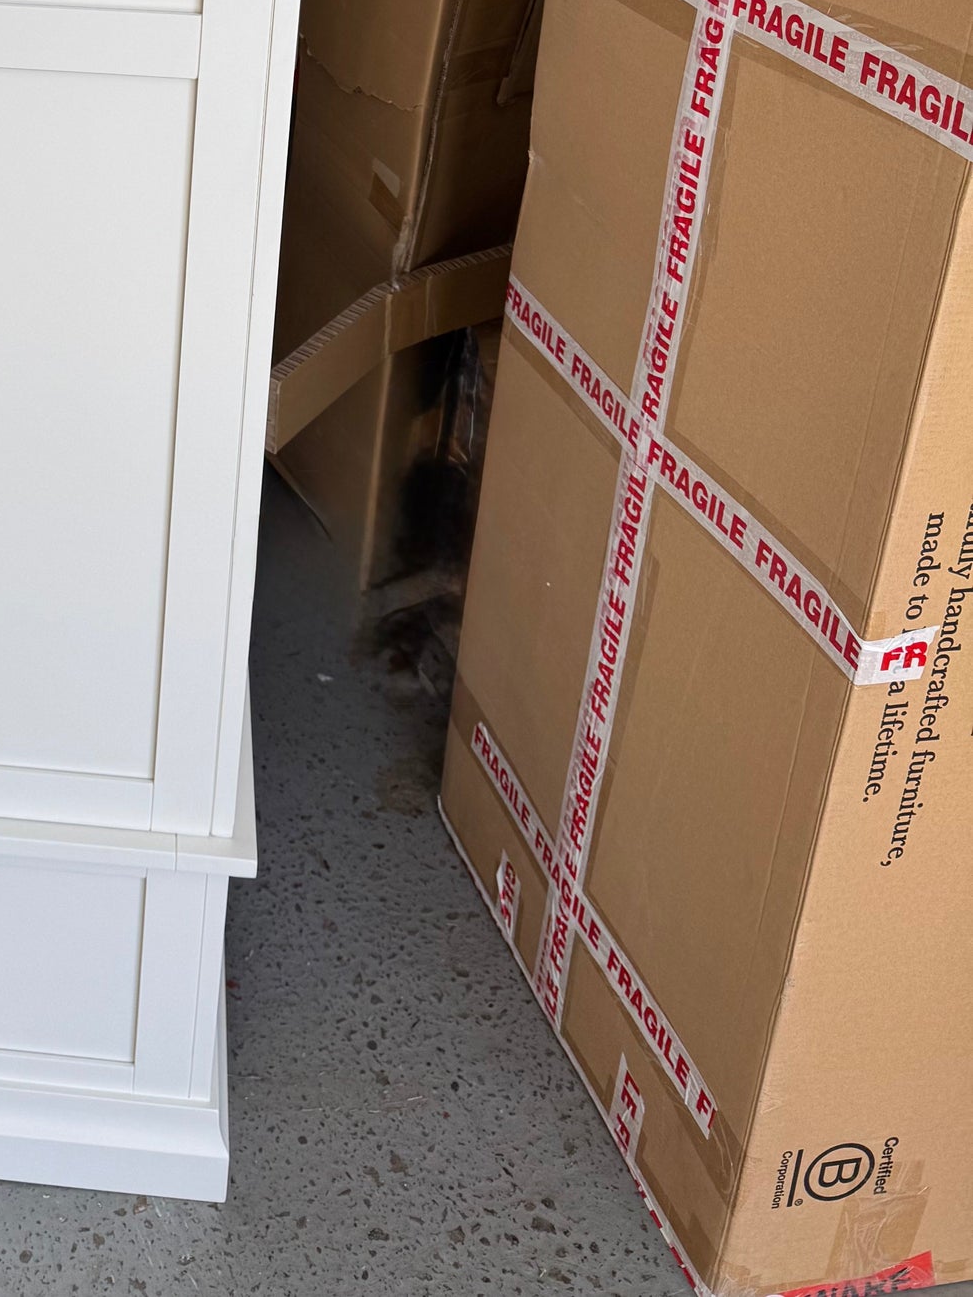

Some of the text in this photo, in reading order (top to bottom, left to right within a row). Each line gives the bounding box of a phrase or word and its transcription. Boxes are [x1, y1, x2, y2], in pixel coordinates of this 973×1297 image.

[860, 52, 973, 146] FRAGIL
[666, 129, 706, 284] FRAGILE
[505, 280, 928, 671] FRAGILE FRAGILE FRAGILE FRAGILE FR
[905, 594, 929, 620] to
[913, 511, 944, 587] made
[590, 589, 627, 724] FRAGILE
[916, 587, 973, 744] handcrafted
[570, 724, 602, 851] FRAGILE
[862, 681, 909, 803] a lifetime.
[880, 749, 936, 867] furniture,
[474, 725, 530, 829] FRAGILE
[535, 828, 601, 951] FRAGILE
[607, 947, 690, 1090] FRAGILE
[770, 1150, 793, 1210] Corporation
[818, 1157, 862, 1188] B
[873, 1136, 900, 1195] Certified
